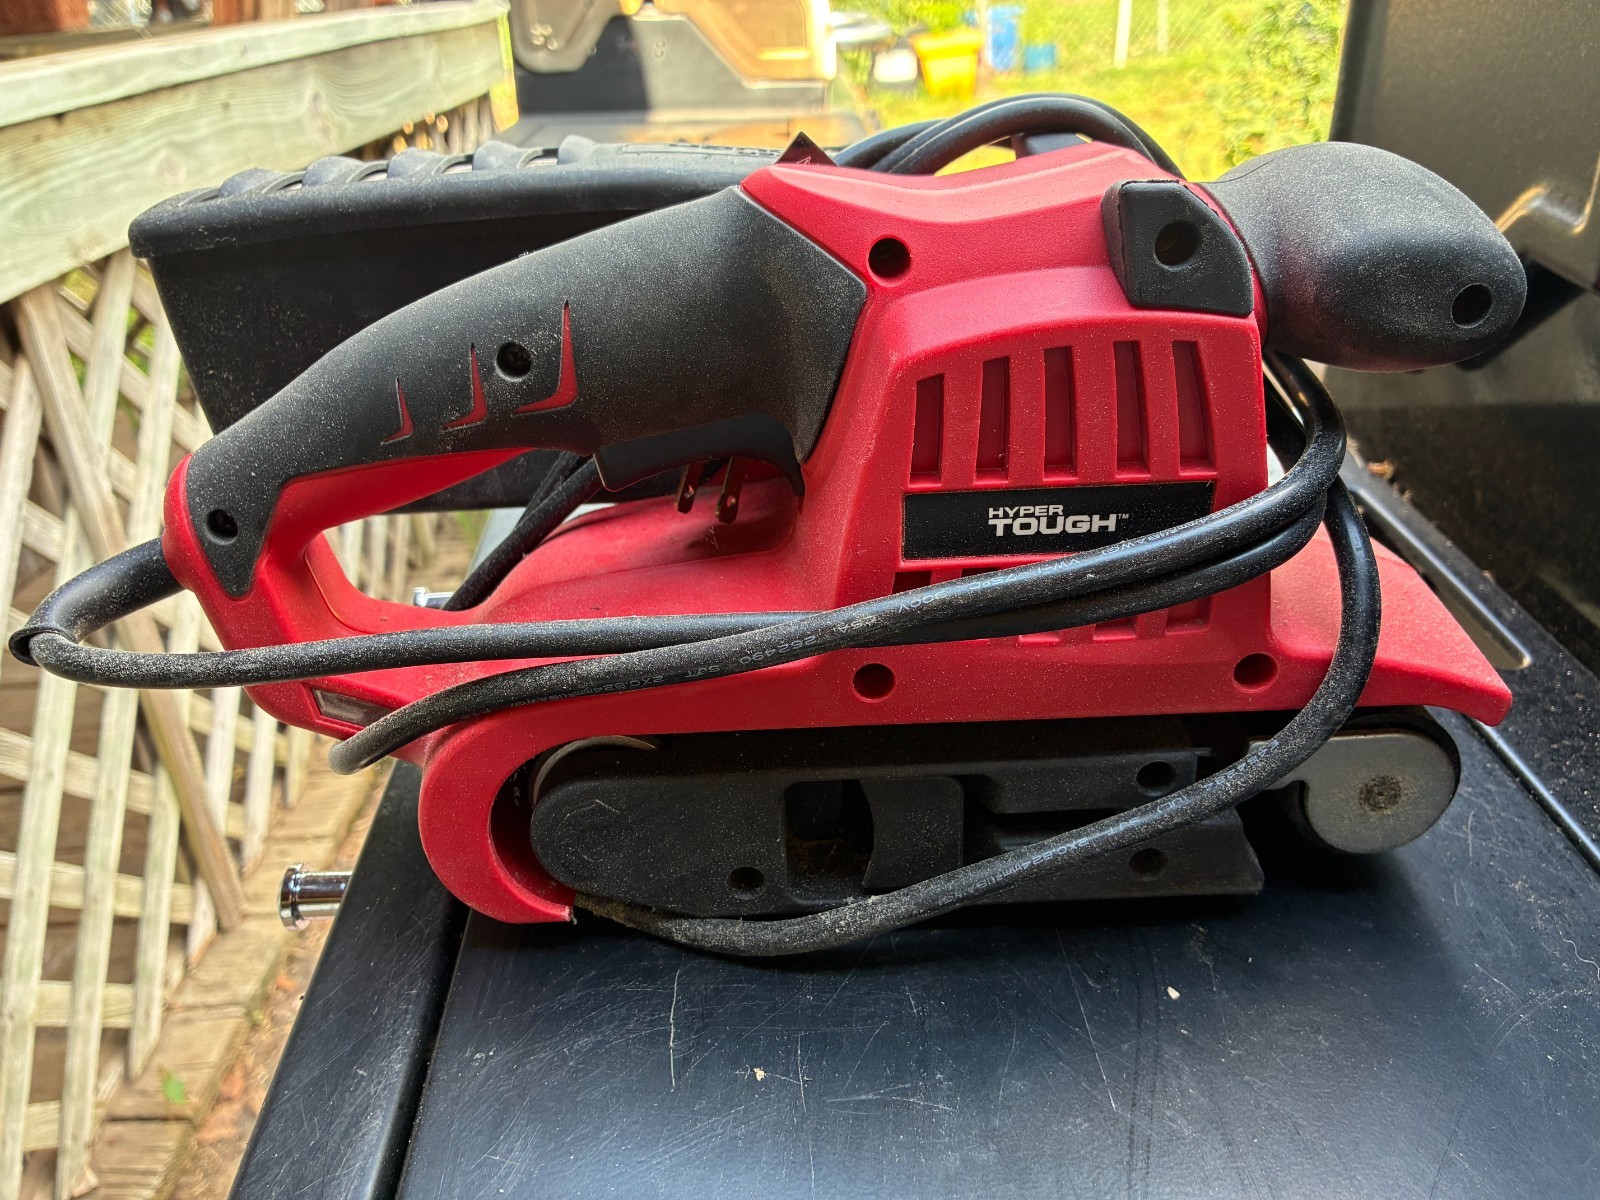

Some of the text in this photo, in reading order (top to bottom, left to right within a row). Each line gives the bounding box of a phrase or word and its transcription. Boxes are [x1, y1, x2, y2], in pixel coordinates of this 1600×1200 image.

[988, 504, 1064, 518] HYPER
[898, 590, 946, 612] 300V
[739, 635, 816, 664] 262490
[685, 664, 720, 678] SJT
